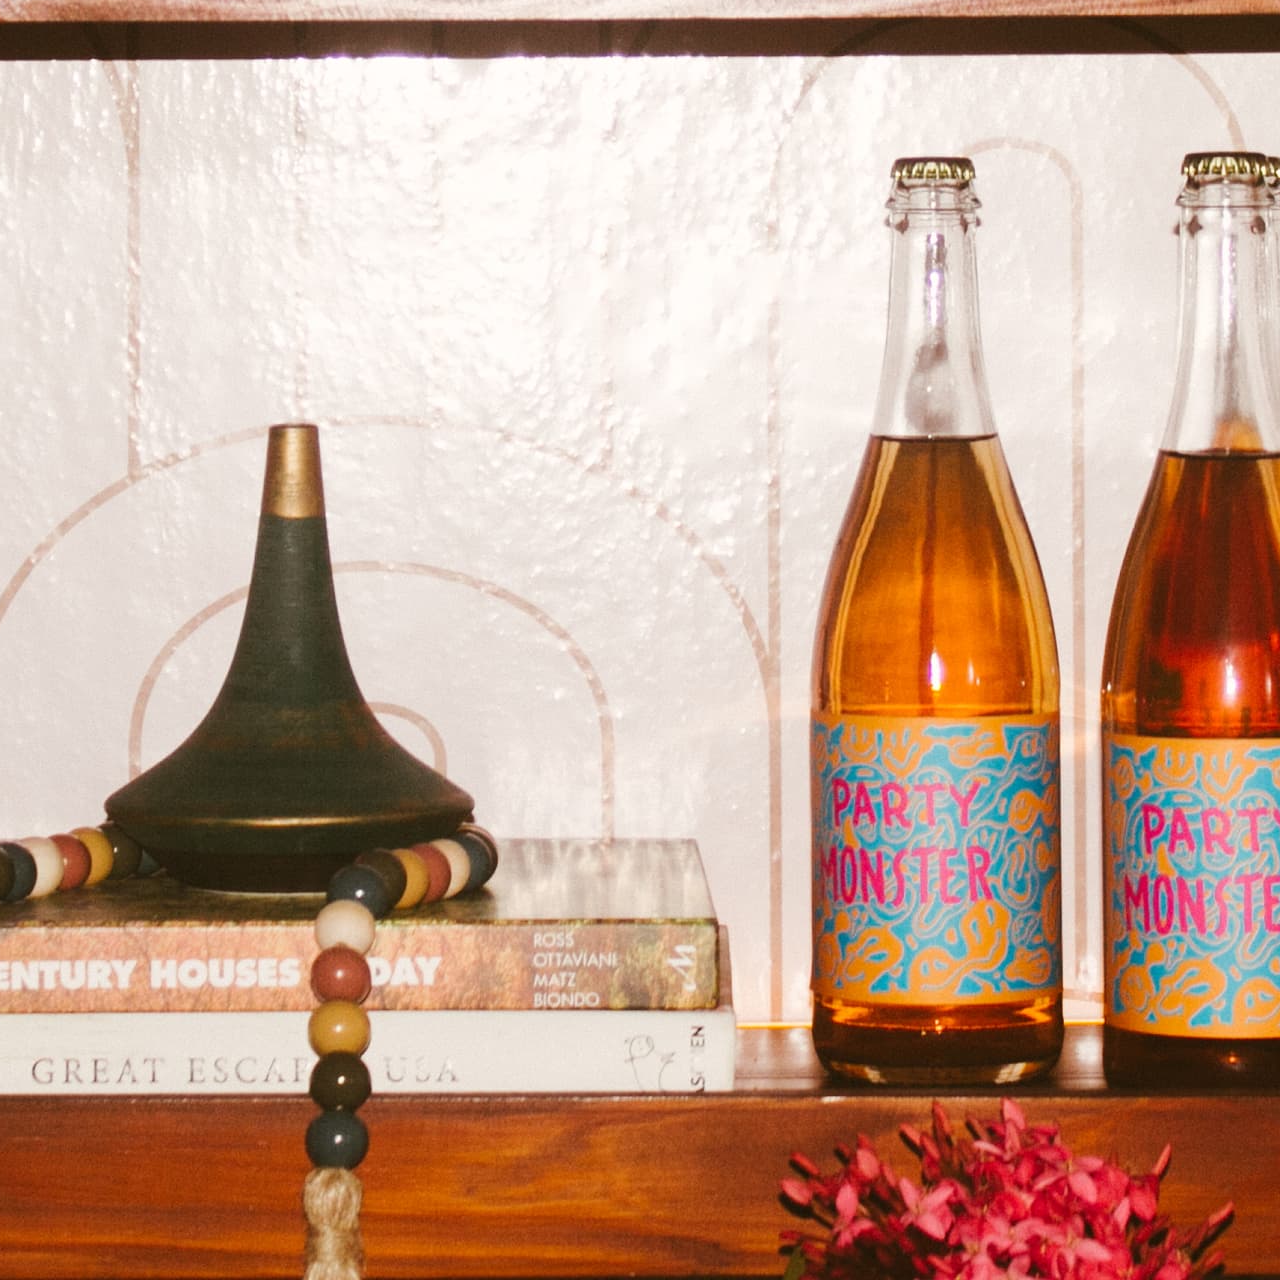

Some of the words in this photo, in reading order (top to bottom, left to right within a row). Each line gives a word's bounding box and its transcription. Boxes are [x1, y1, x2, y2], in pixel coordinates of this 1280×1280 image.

[832, 777, 982, 828] PARTY
[820, 846, 995, 907] MONSTER
[533, 932, 575, 948] ROSS
[533, 951, 618, 969] OTTAVIANI
[150, 957, 302, 989] HOUSES
[368, 956, 443, 987] DAY
[533, 971, 577, 987] MATZ
[533, 991, 601, 1008] BIONDO
[30, 1057, 166, 1085] GREAT
[382, 1056, 461, 1084] USA
